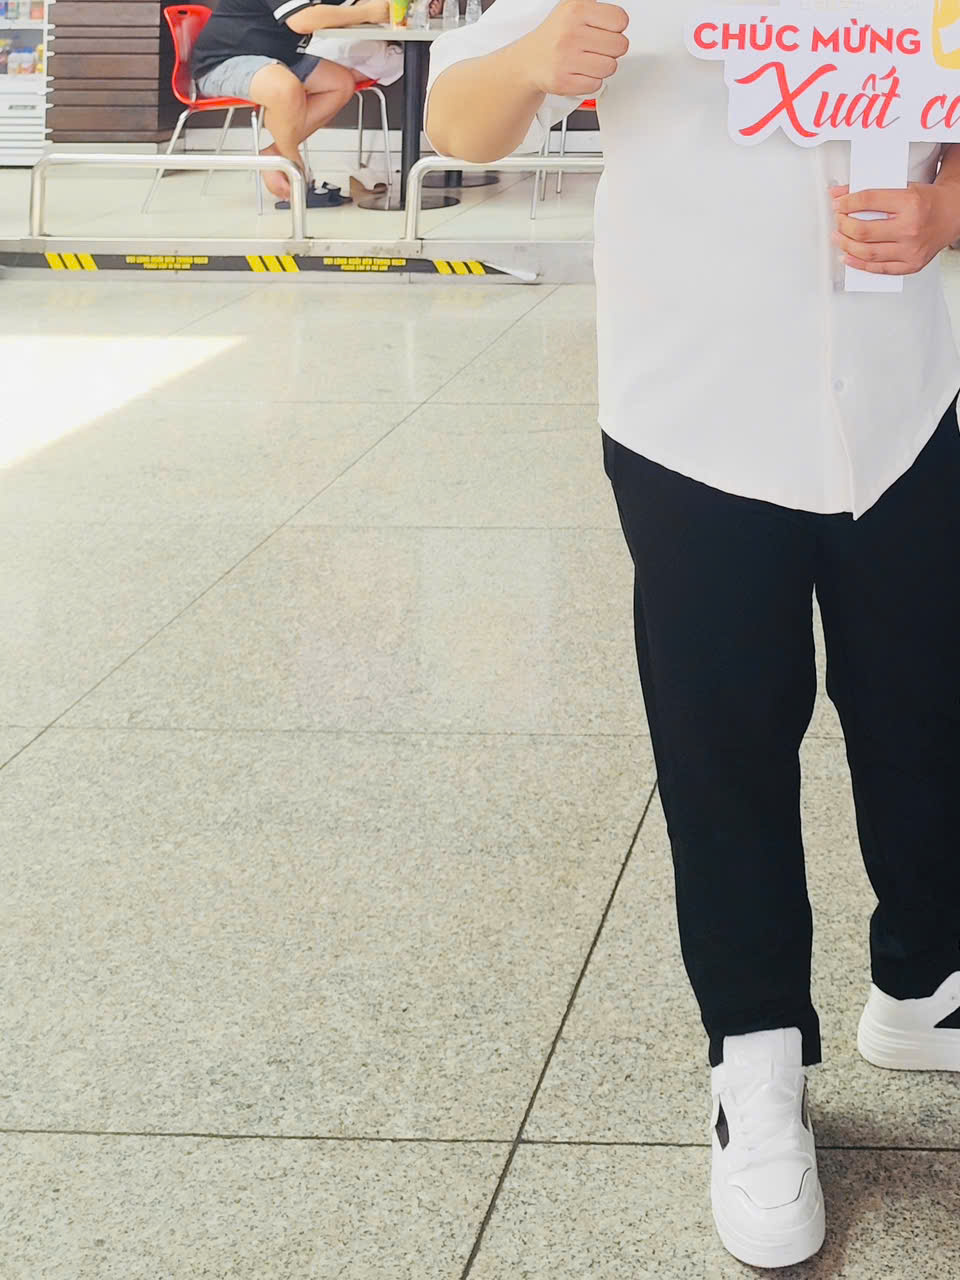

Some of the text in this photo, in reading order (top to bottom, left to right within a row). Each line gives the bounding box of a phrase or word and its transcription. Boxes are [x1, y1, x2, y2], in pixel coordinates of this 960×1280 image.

[693, 16, 920, 55] CHÚC MỪNG
[734, 62, 900, 137] Xuất
